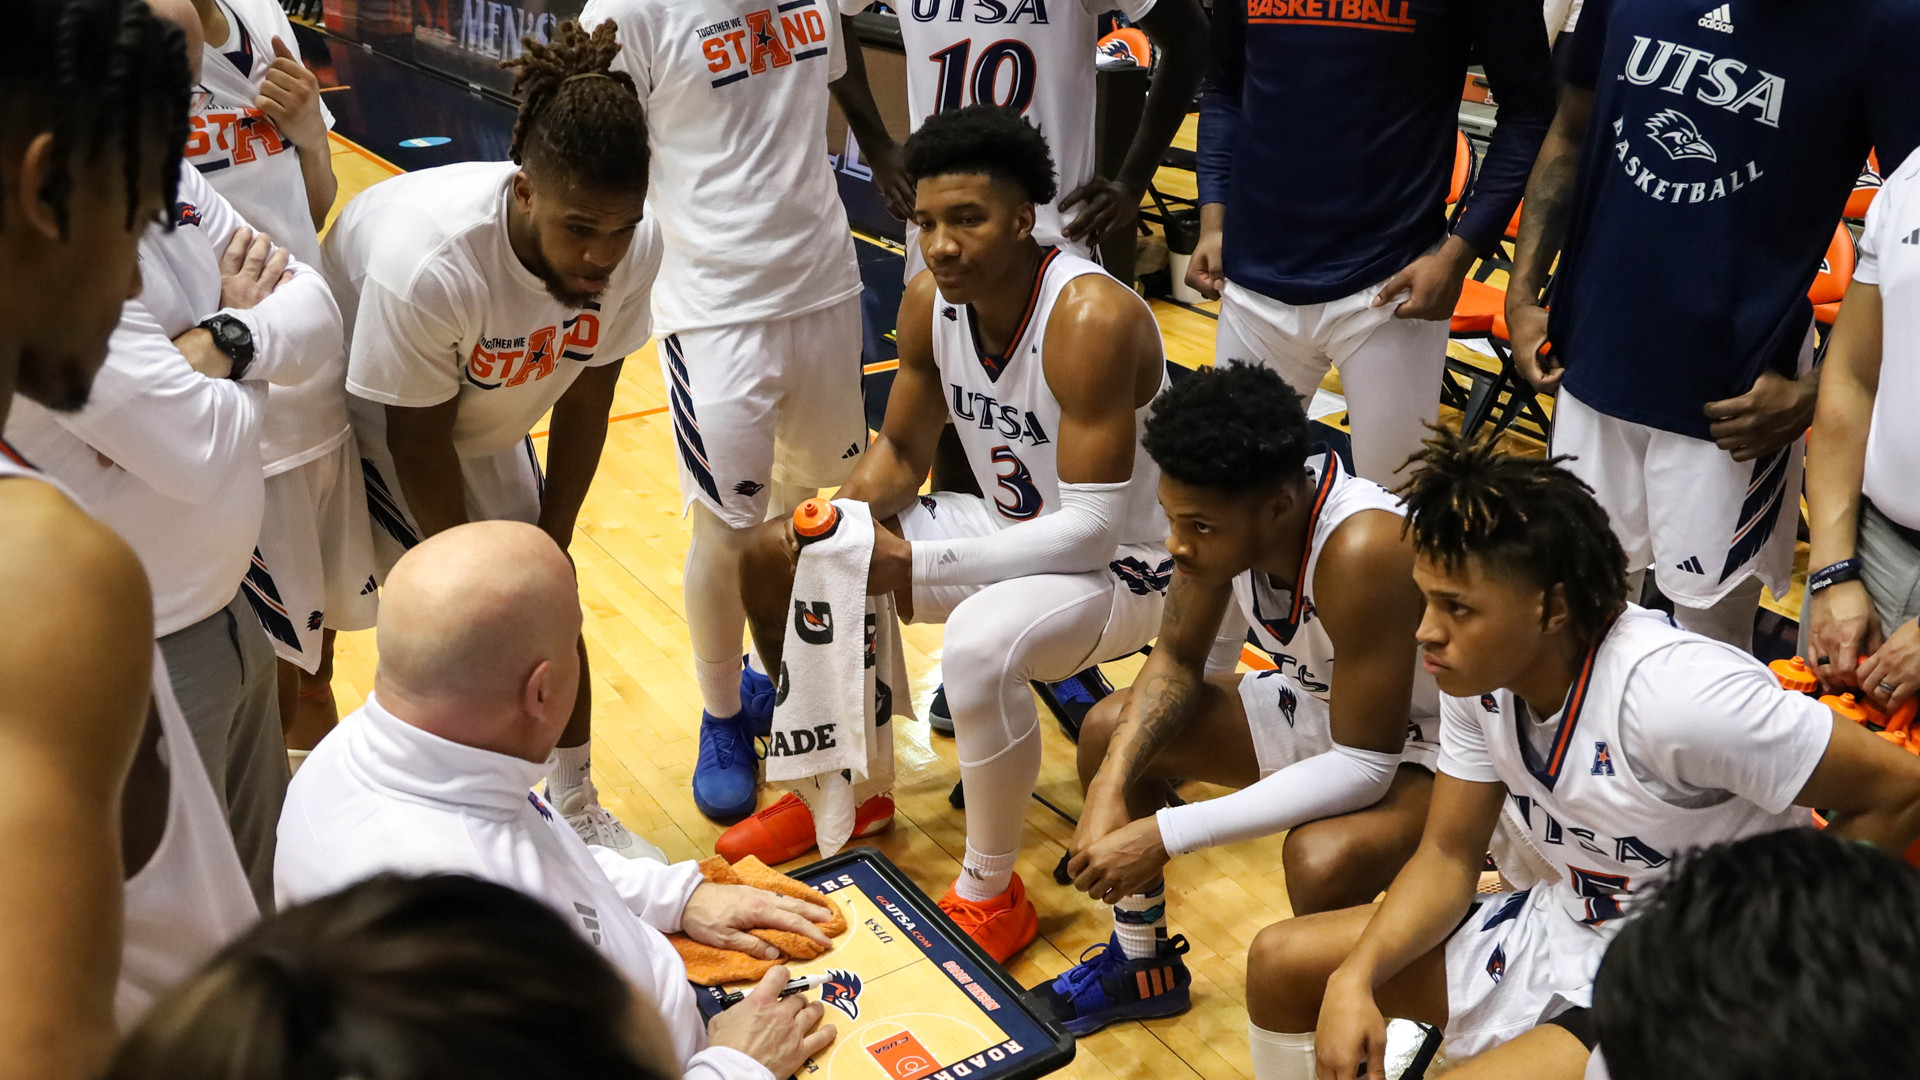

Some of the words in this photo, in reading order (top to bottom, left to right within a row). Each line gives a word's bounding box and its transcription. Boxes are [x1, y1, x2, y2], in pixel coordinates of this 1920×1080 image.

[696, 21, 731, 38] TOGETHER
[730, 18, 742, 29] WE
[702, 9, 826, 75] STAND
[1698, 17, 1734, 34] adidas
[926, 37, 1037, 118] 10
[1625, 35, 1786, 128] UTSA
[470, 313, 600, 387] STAD
[514, 337, 526, 348] WE
[950, 383, 1051, 447] UTSA
[991, 445, 1043, 521] 3
[865, 918, 894, 944] UTSA
[875, 895, 932, 948] GOUTSA.COM
[942, 961, 974, 985] COACH
[964, 982, 1001, 1011] HENSON
[924, 1040, 1024, 1080] ROADR
